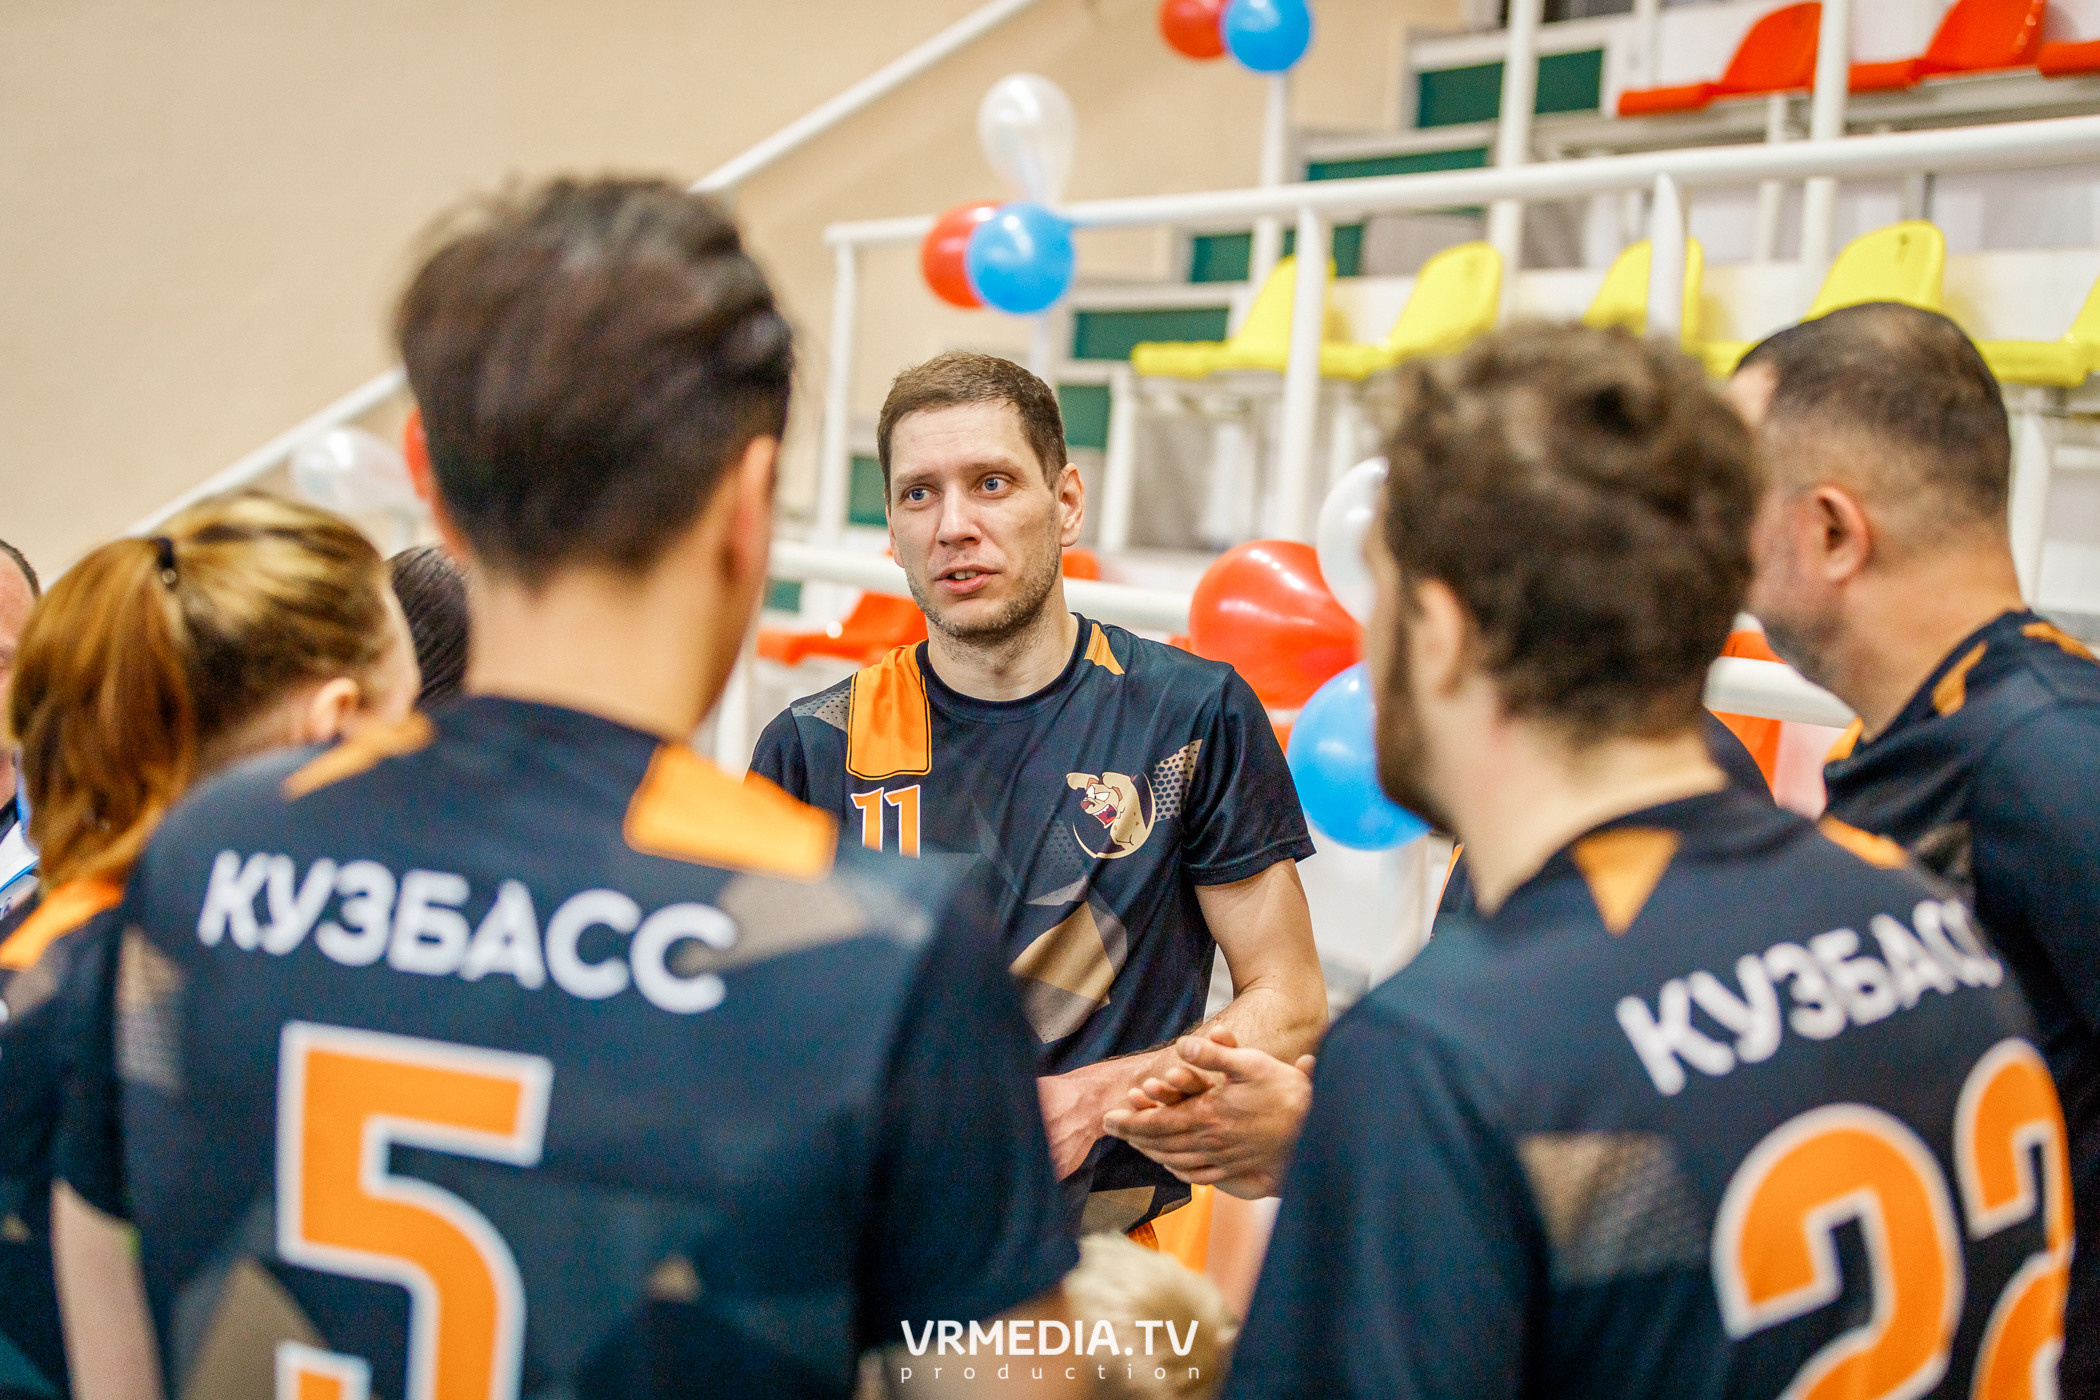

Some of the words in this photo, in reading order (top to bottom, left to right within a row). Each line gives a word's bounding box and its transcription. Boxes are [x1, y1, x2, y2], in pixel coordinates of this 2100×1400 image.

[198, 850, 739, 1014] КУЗБАСС
[850, 785, 921, 859] 11
[275, 1020, 553, 1400] 5
[1710, 1037, 2076, 1400] 22
